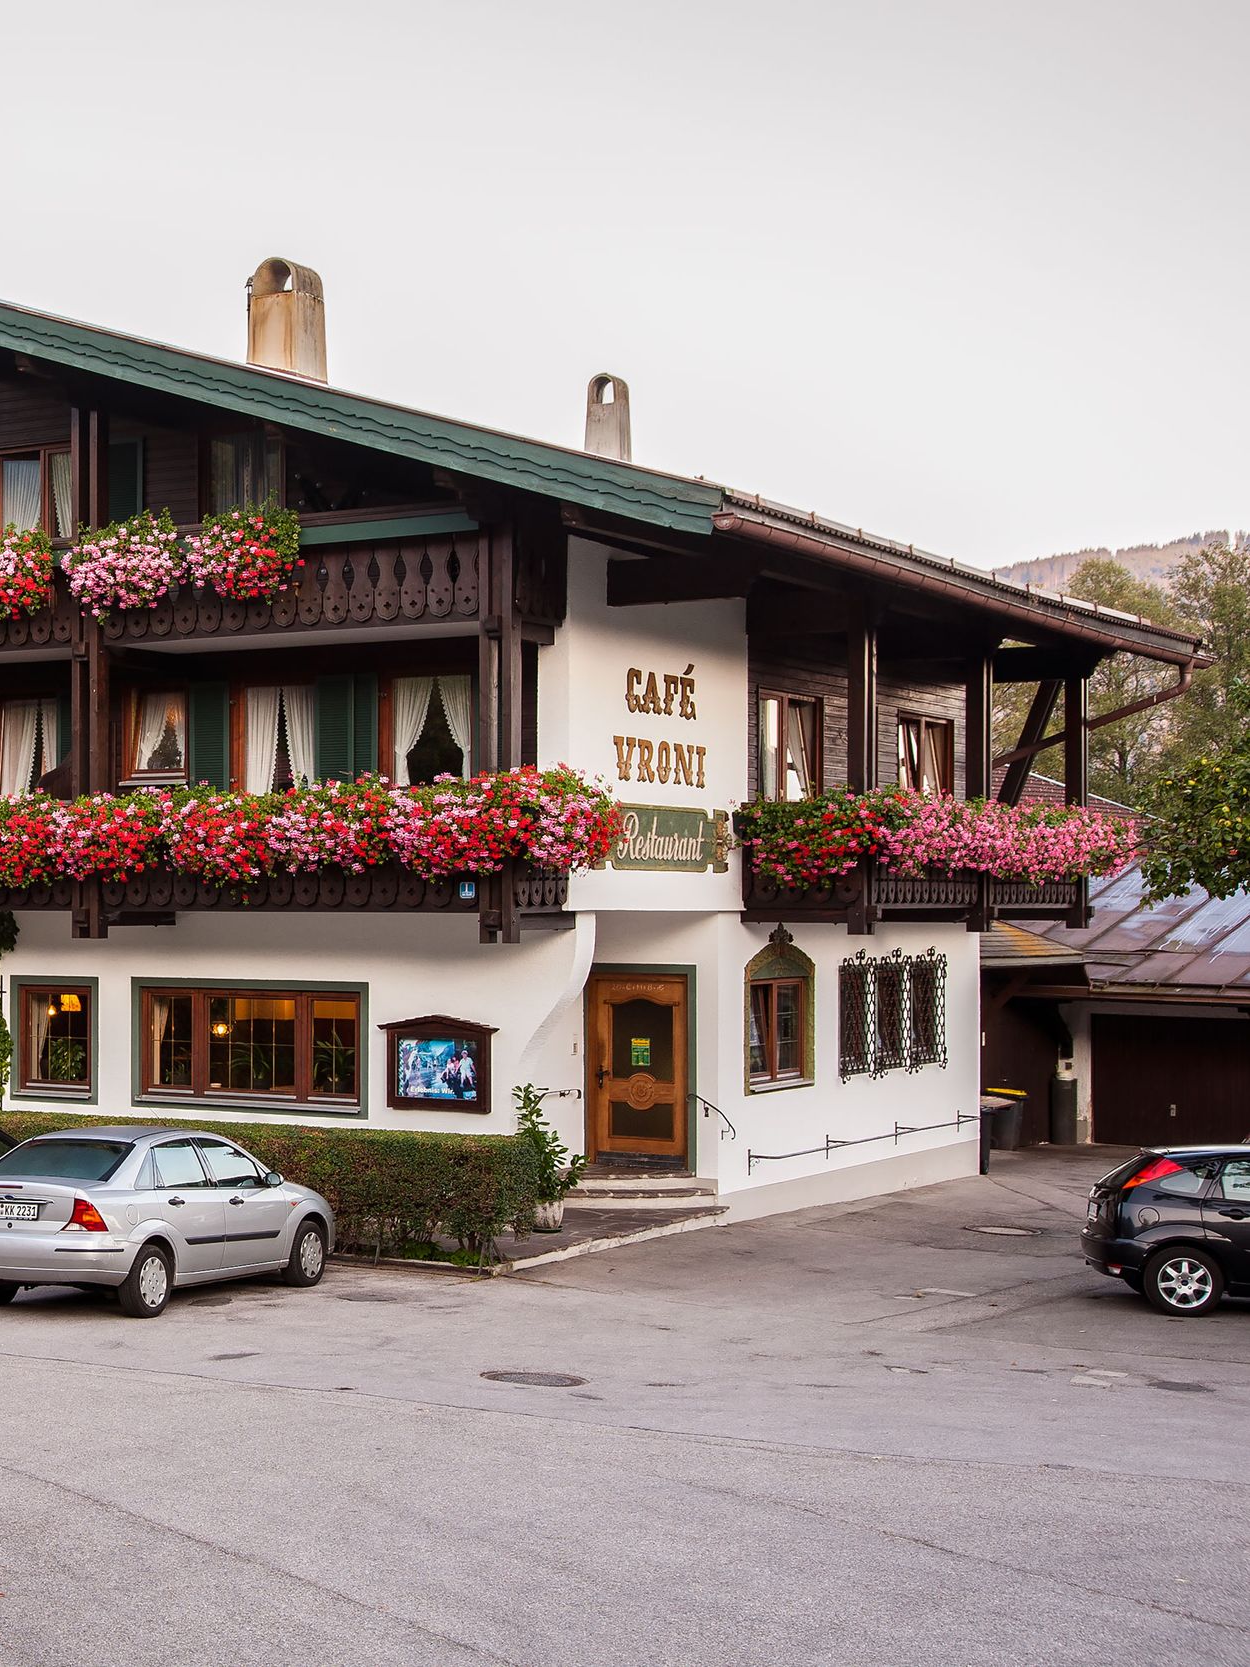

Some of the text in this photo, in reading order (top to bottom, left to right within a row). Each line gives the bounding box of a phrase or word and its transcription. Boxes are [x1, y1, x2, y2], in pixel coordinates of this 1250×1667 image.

[625, 663, 697, 720] CAFÉ
[613, 735, 706, 789] VRONI
[617, 812, 705, 862] Restaurant
[4, 1205, 15, 1216] KK
[16, 1206, 37, 1217] 2231
